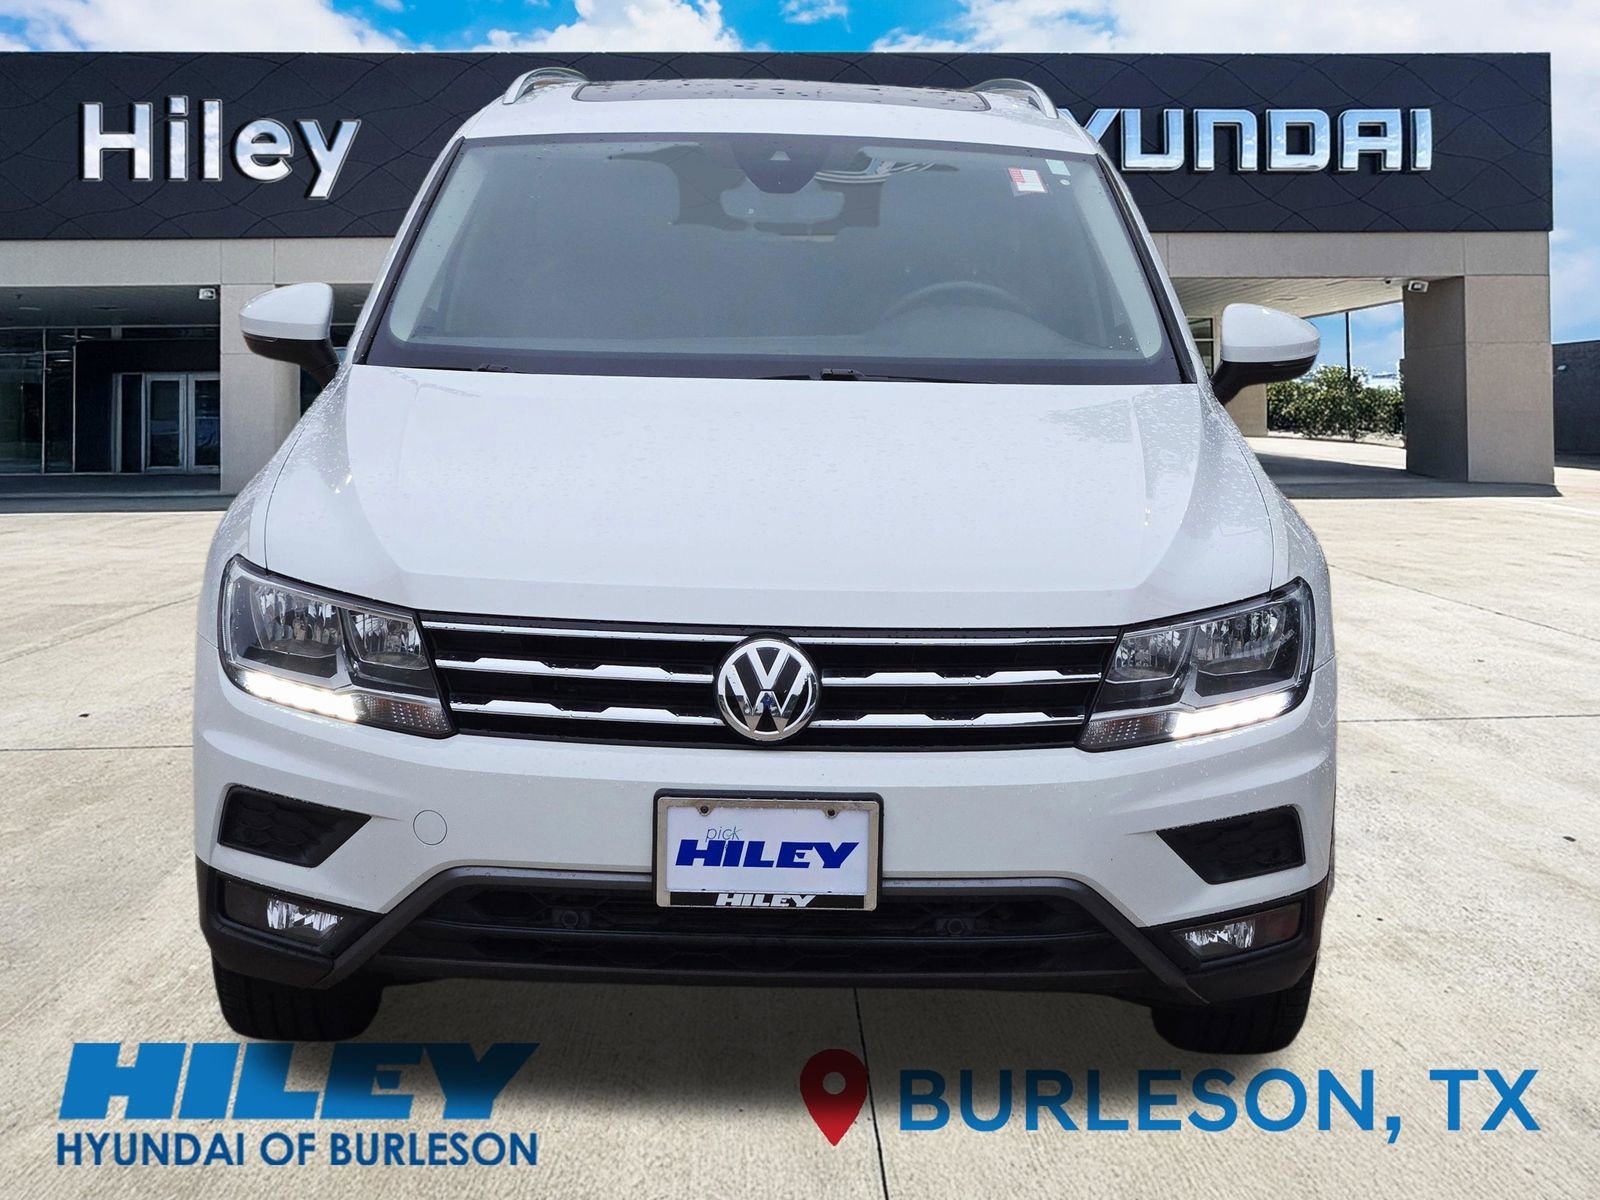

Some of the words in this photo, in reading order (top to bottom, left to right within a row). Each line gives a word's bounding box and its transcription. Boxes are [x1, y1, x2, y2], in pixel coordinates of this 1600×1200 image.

[80, 95, 362, 200] Hiley
[705, 826, 742, 842] pick
[675, 839, 859, 868] HILEY
[715, 893, 816, 907] HILEY
